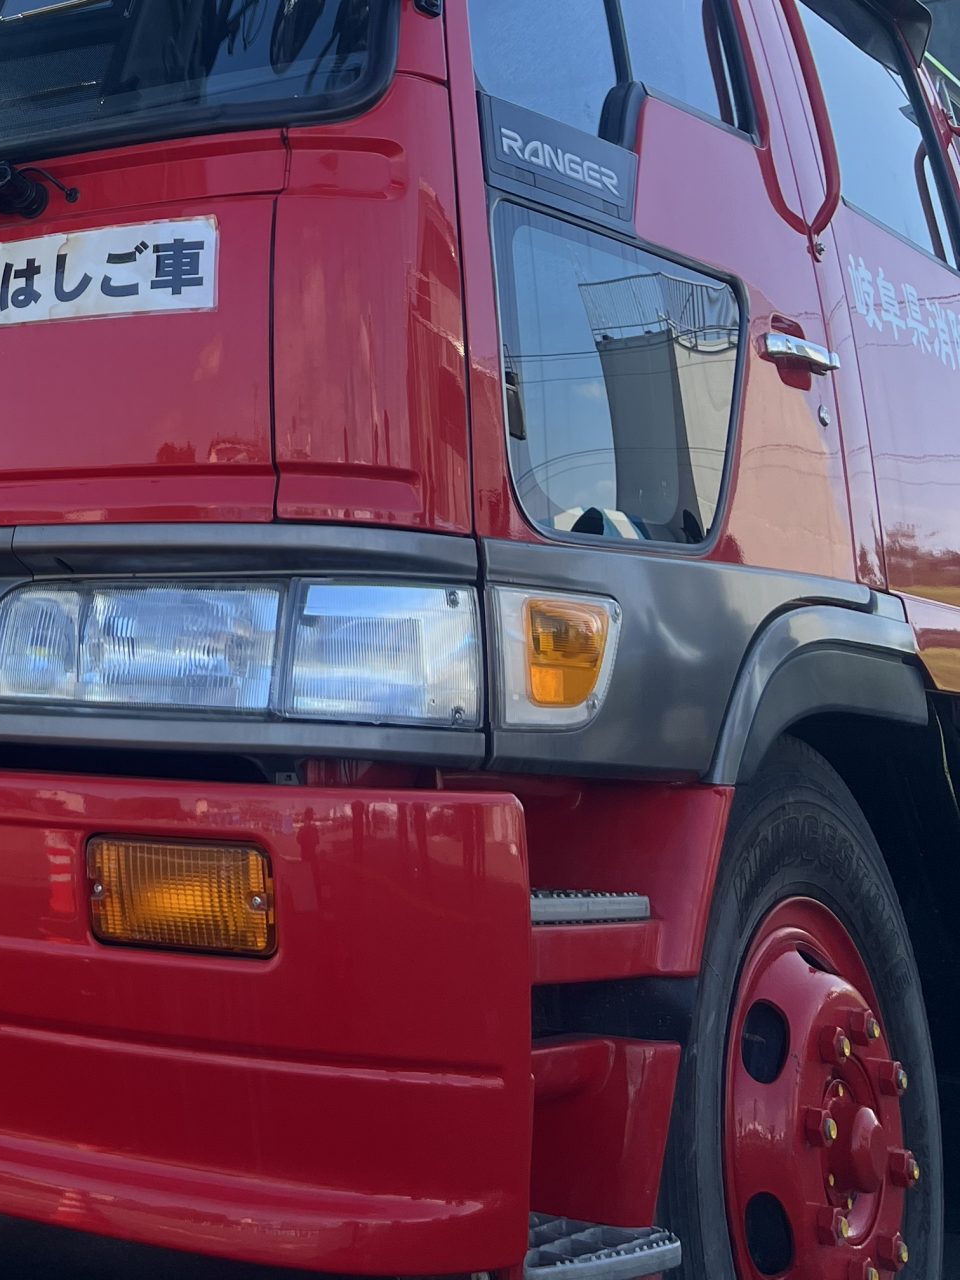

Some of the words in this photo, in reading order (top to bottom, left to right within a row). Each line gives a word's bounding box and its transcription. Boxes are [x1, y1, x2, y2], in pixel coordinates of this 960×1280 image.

[501, 127, 621, 198] RANGER
[0, 238, 205, 312] はしご車
